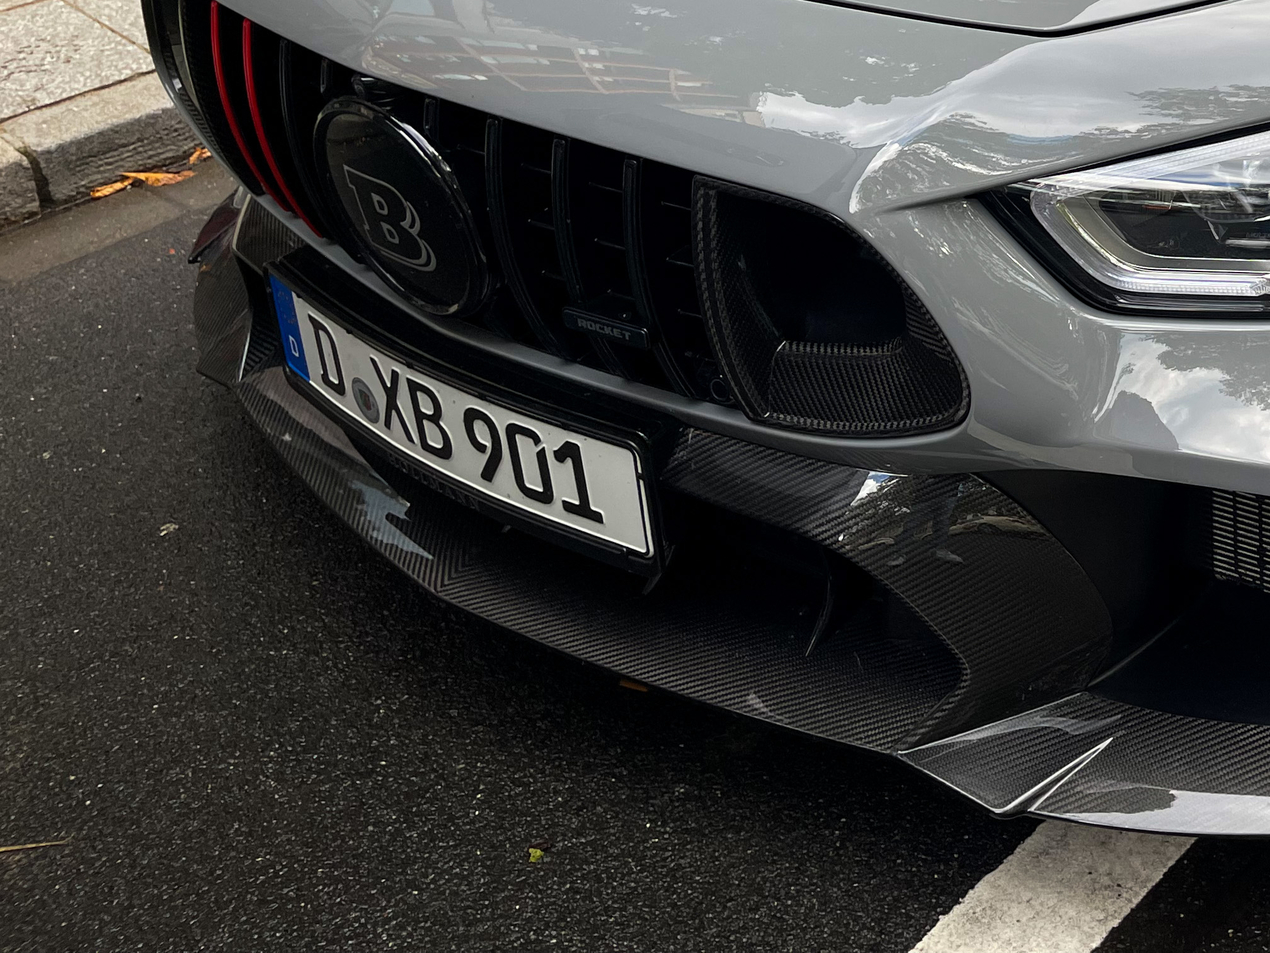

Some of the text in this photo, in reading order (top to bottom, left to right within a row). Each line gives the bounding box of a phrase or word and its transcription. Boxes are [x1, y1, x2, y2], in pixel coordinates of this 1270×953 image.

[577, 317, 632, 340] ROCKET
[288, 334, 300, 358] D
[308, 313, 605, 526] D XB 901
